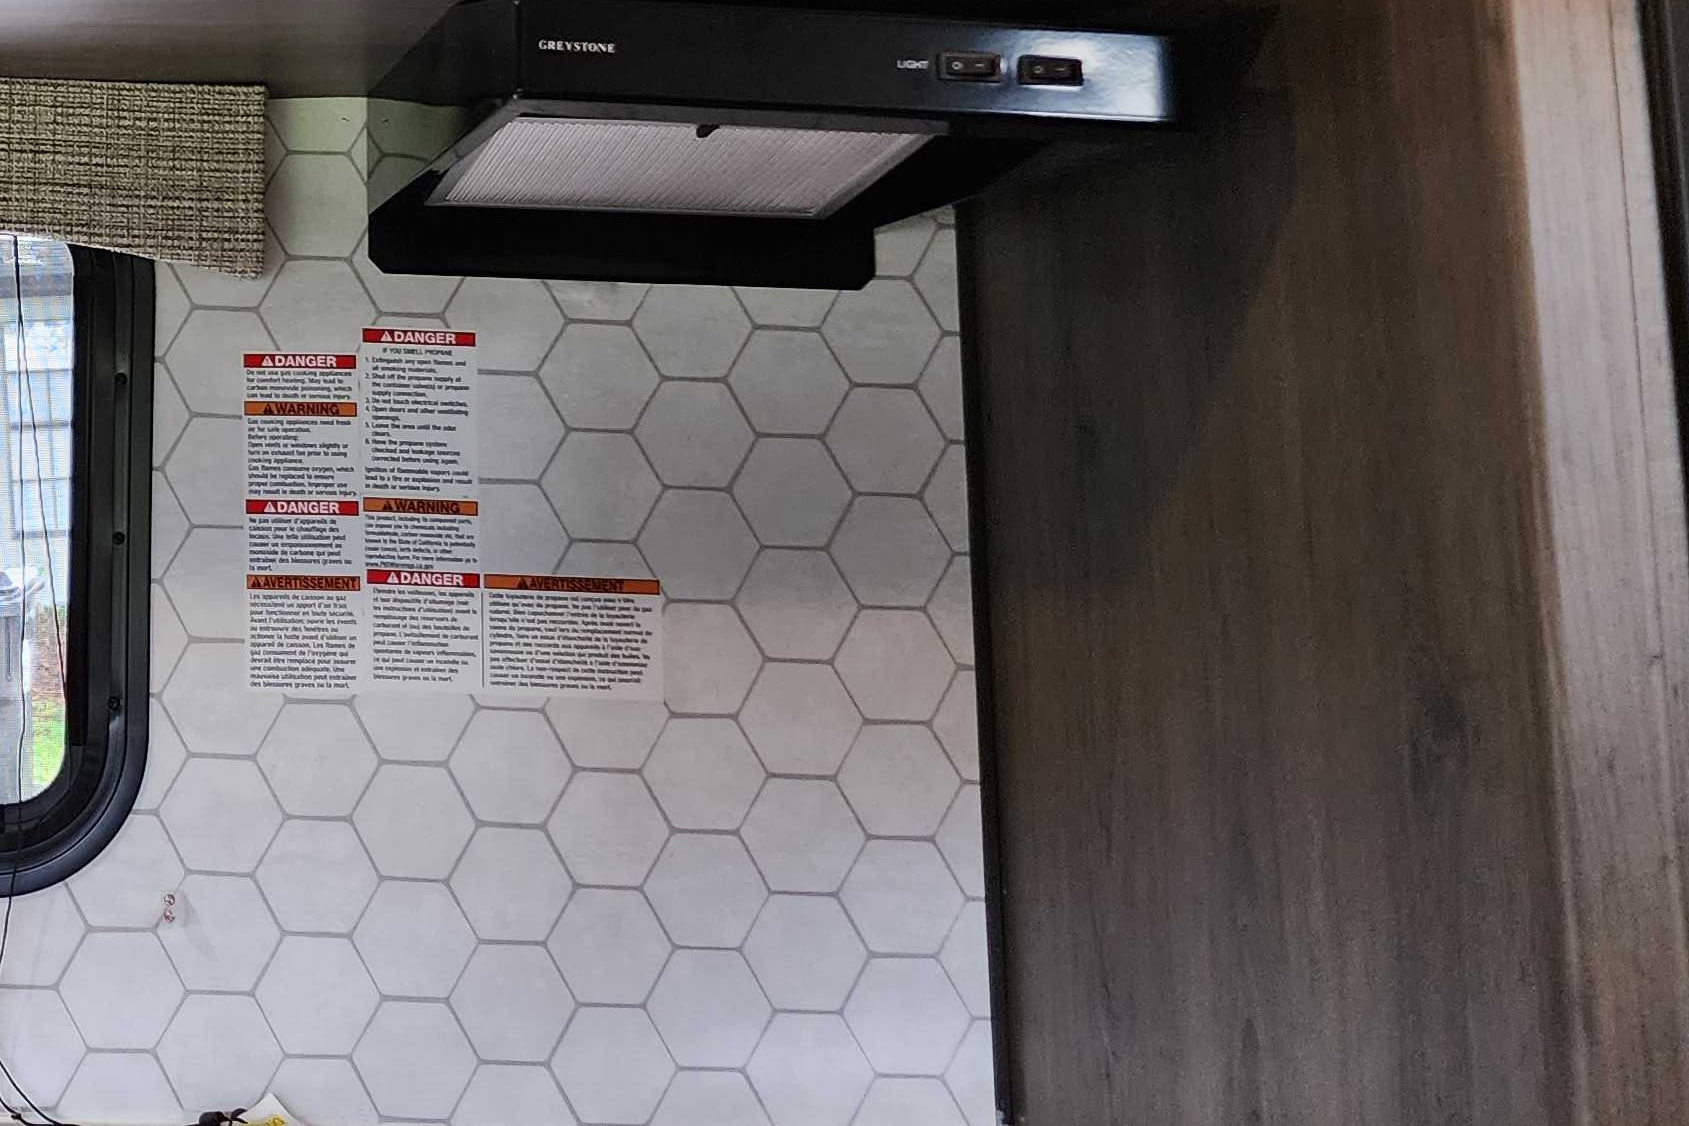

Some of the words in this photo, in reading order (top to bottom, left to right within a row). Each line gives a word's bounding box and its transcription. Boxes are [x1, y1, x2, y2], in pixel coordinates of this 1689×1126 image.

[539, 40, 615, 53] GREYSTONE
[896, 59, 928, 69] LIGHT
[394, 332, 456, 344] DANGER
[275, 356, 337, 367] DANGER
[275, 404, 340, 415] WARNING
[372, 406, 387, 414] Open
[277, 502, 339, 514] DANGER
[395, 500, 460, 513] WARNING
[262, 577, 356, 589] AVERTISSEMENT
[401, 572, 464, 585] DANGER
[530, 578, 624, 591] AVERTISSEMENT
